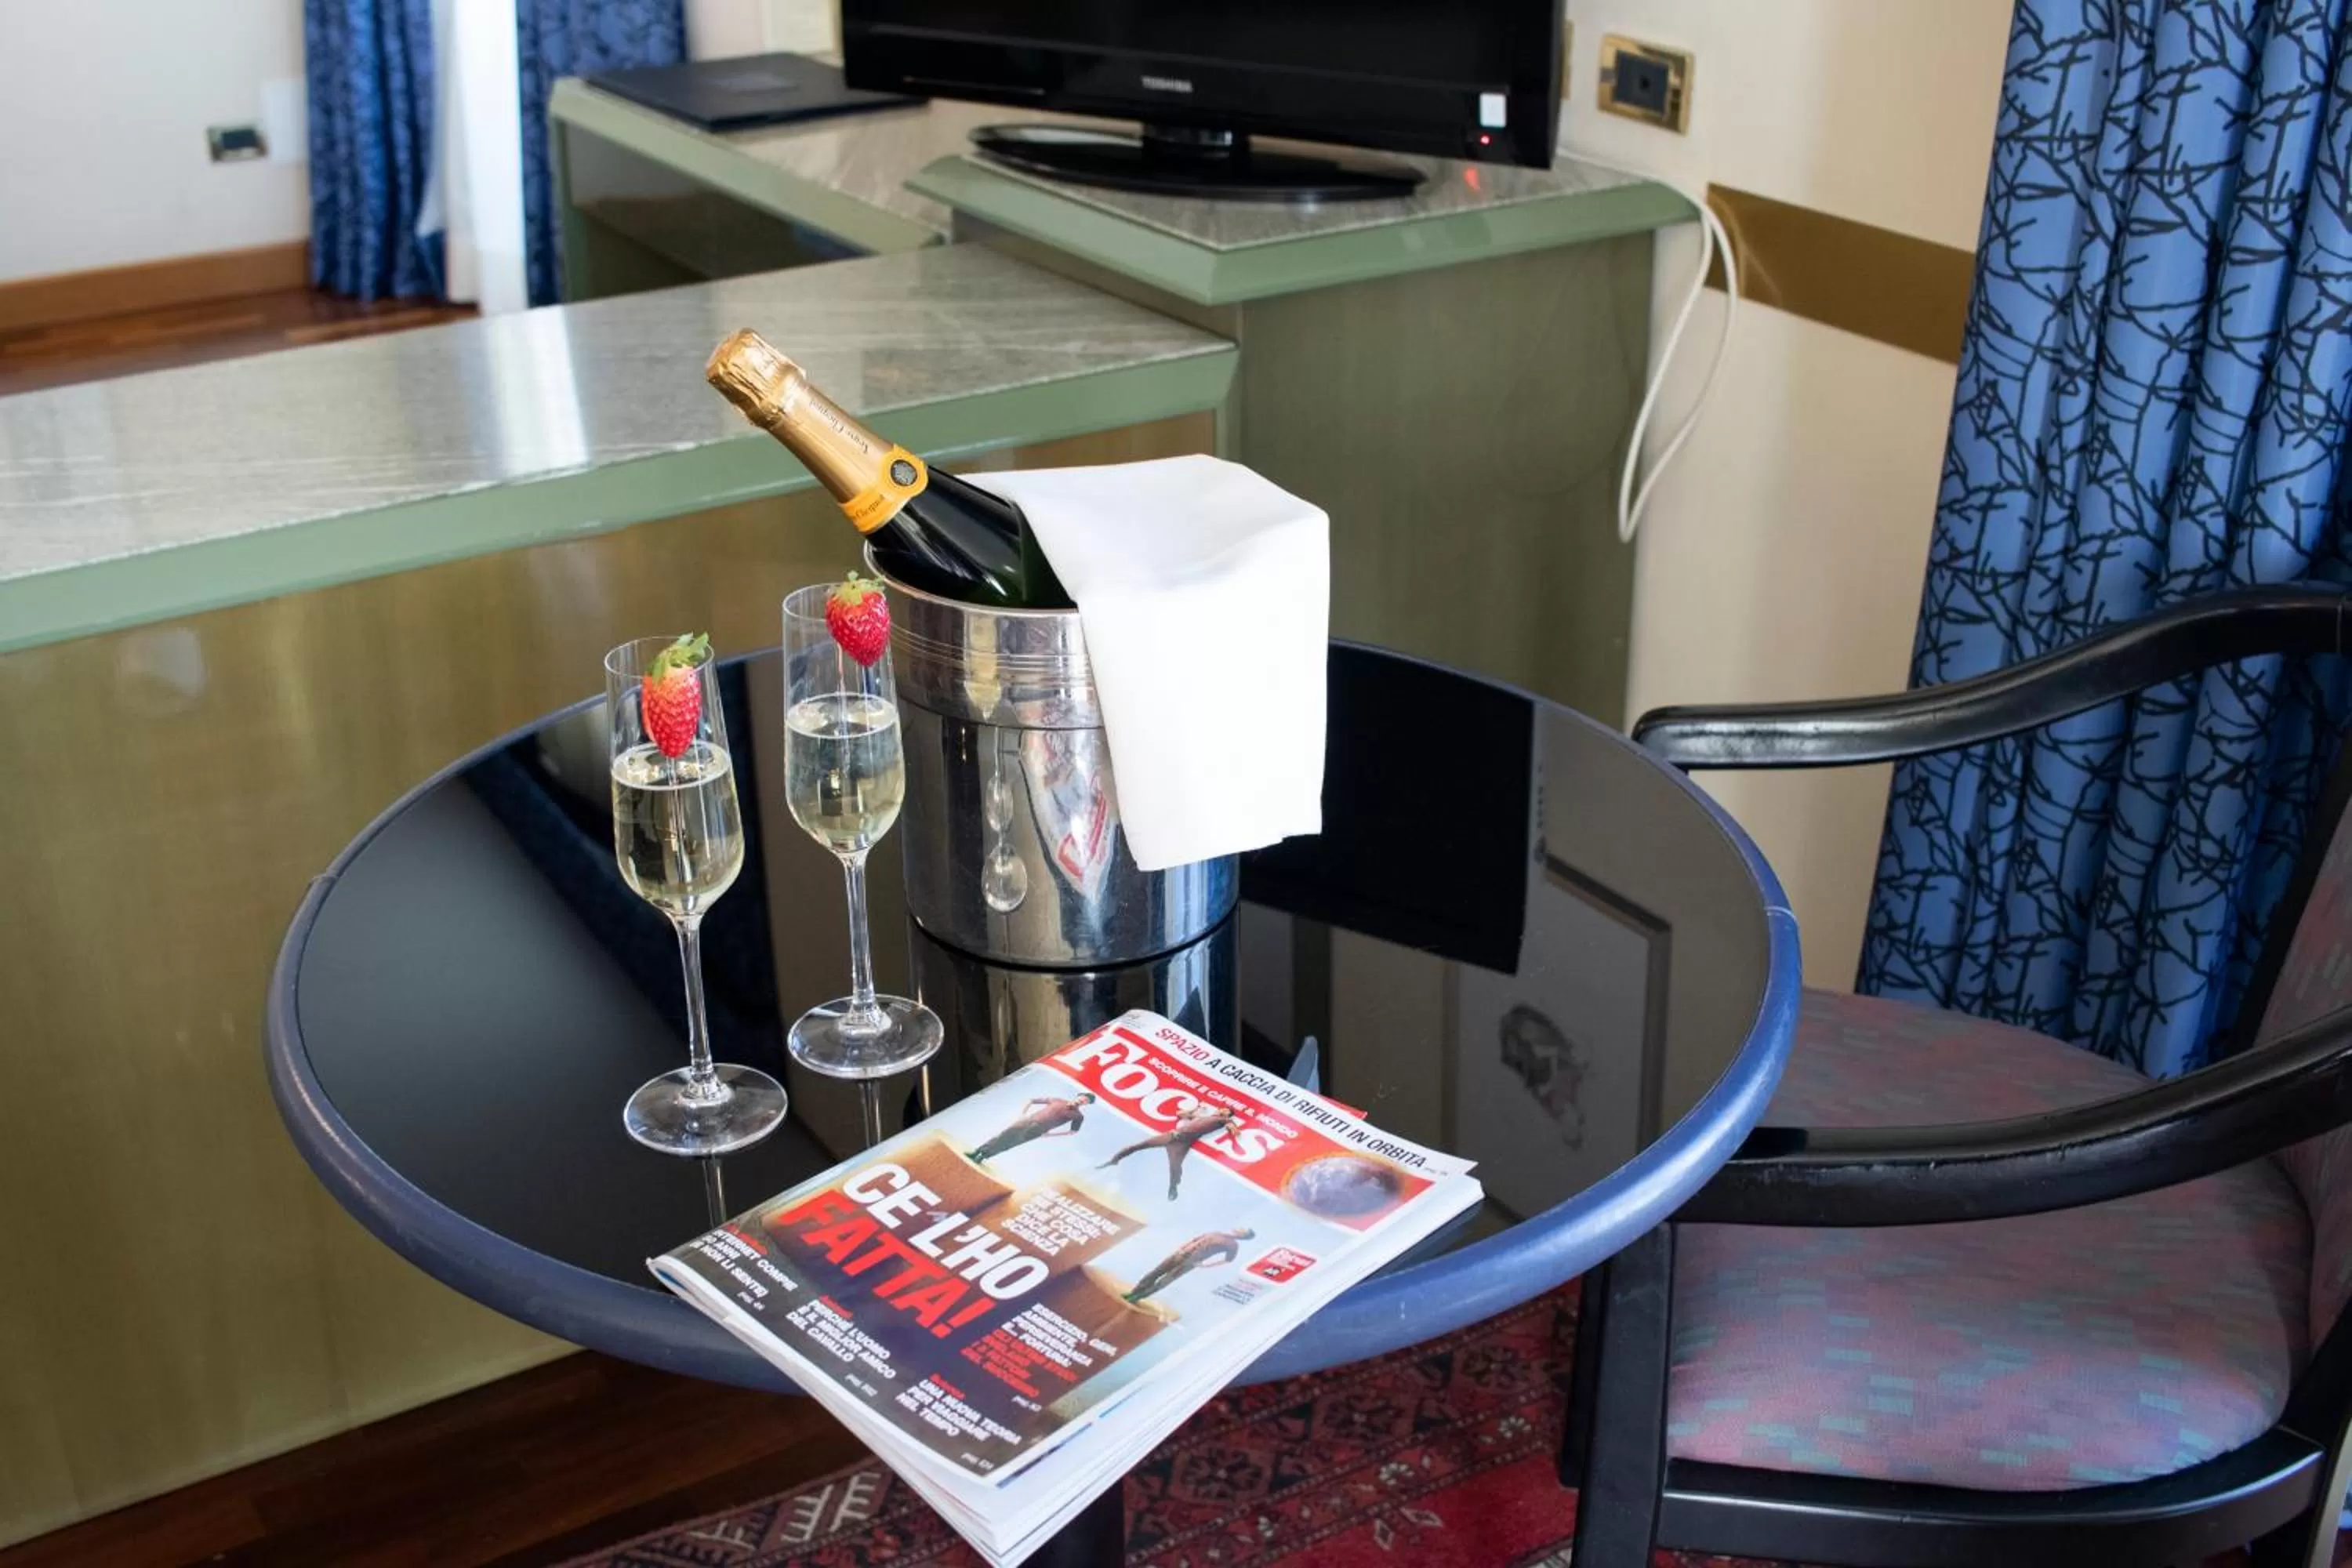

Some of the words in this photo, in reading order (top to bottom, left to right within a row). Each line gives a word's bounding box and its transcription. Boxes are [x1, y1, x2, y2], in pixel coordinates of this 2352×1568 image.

[1147, 1057, 1202, 1089] SCOPRIRE
[1254, 1112, 1299, 1138] MONDO
[1155, 1028, 1210, 1061] SPAZIO
[1207, 1058, 1221, 1069] A
[1219, 1063, 1276, 1095] CACCIA
[1274, 1089, 1298, 1104] DI
[1294, 1098, 1350, 1134] RIFIUTI
[1347, 1127, 1369, 1144] IN
[1366, 1134, 1427, 1169] ORBITA
[843, 1163, 942, 1229] CE
[907, 1211, 1050, 1301] L'HO
[1000, 1218, 1061, 1256] SCIENZA
[1047, 1231, 1070, 1248] LA
[779, 1189, 997, 1339] FATTA!
[785, 1311, 808, 1330] DEL
[806, 1327, 855, 1363] CAVALLO
[815, 1319, 863, 1354] MIGLIOR
[857, 1350, 897, 1379] AMICO
[919, 1406, 960, 1437] TEMPO
